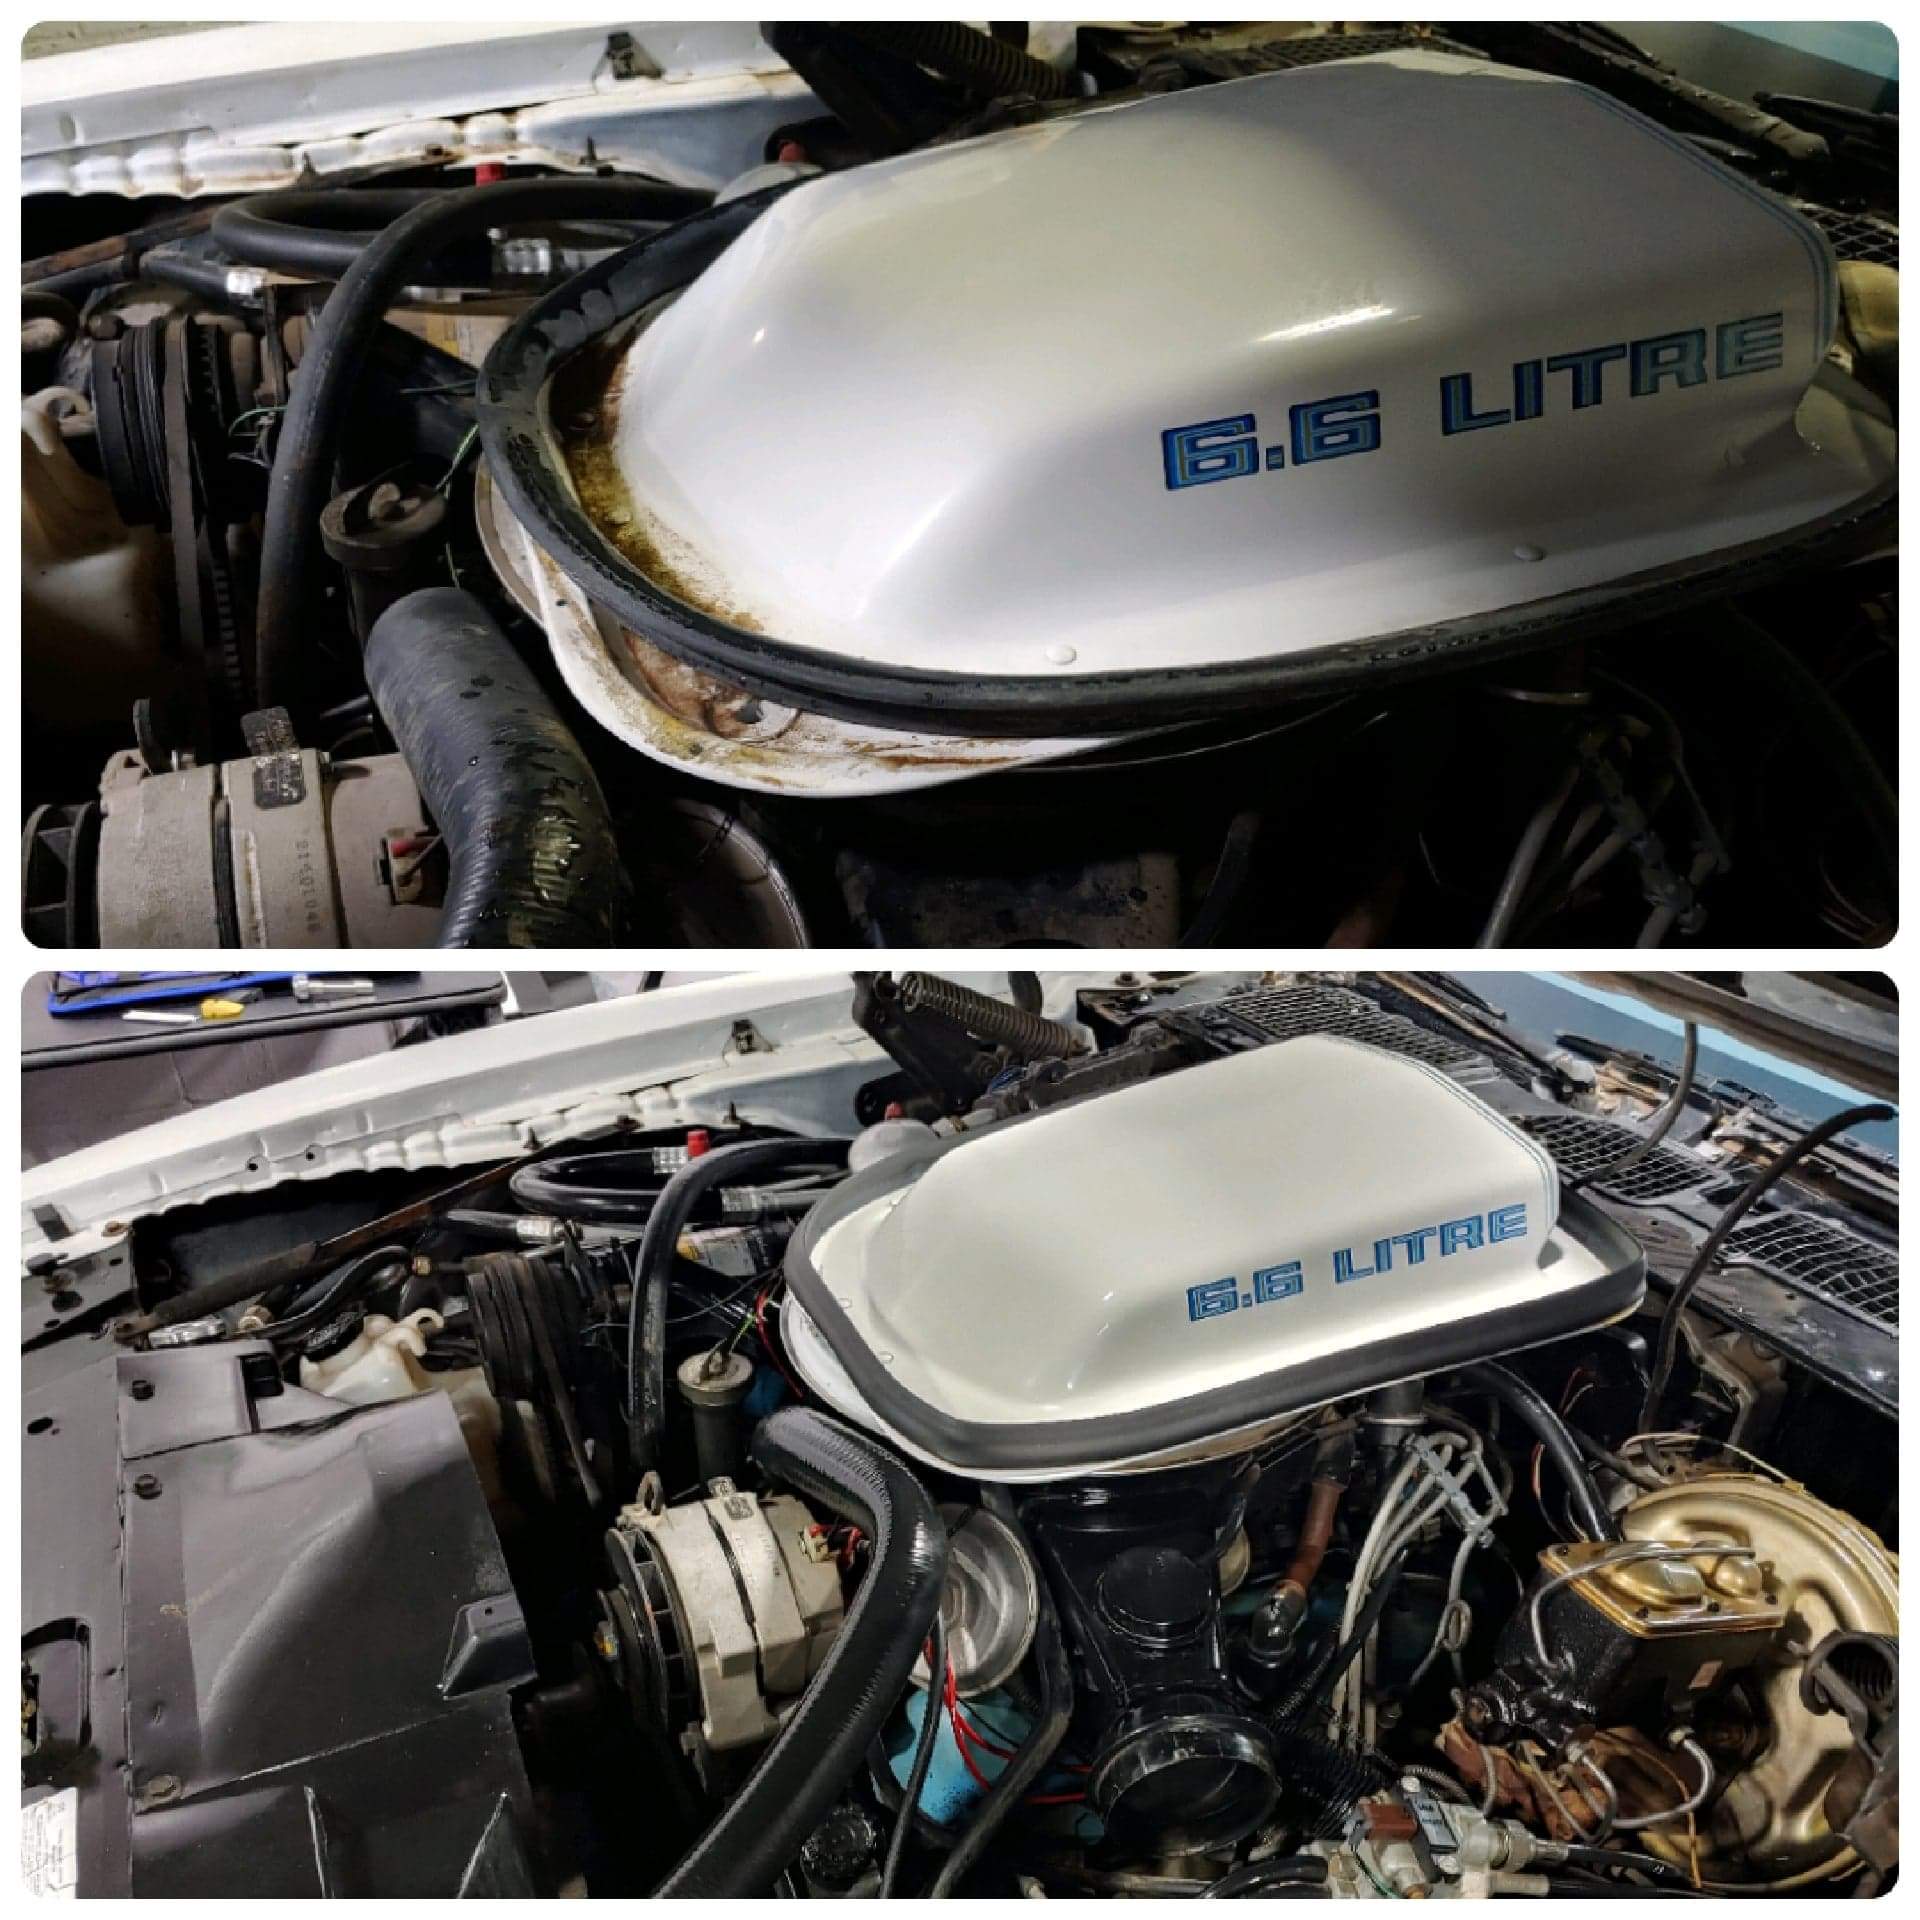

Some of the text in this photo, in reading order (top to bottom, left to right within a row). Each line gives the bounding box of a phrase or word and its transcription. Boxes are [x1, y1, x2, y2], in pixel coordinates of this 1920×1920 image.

[1161, 312, 1783, 490] 6.6 LITRE
[1186, 1203, 1527, 1322] 6.6 LITRE
